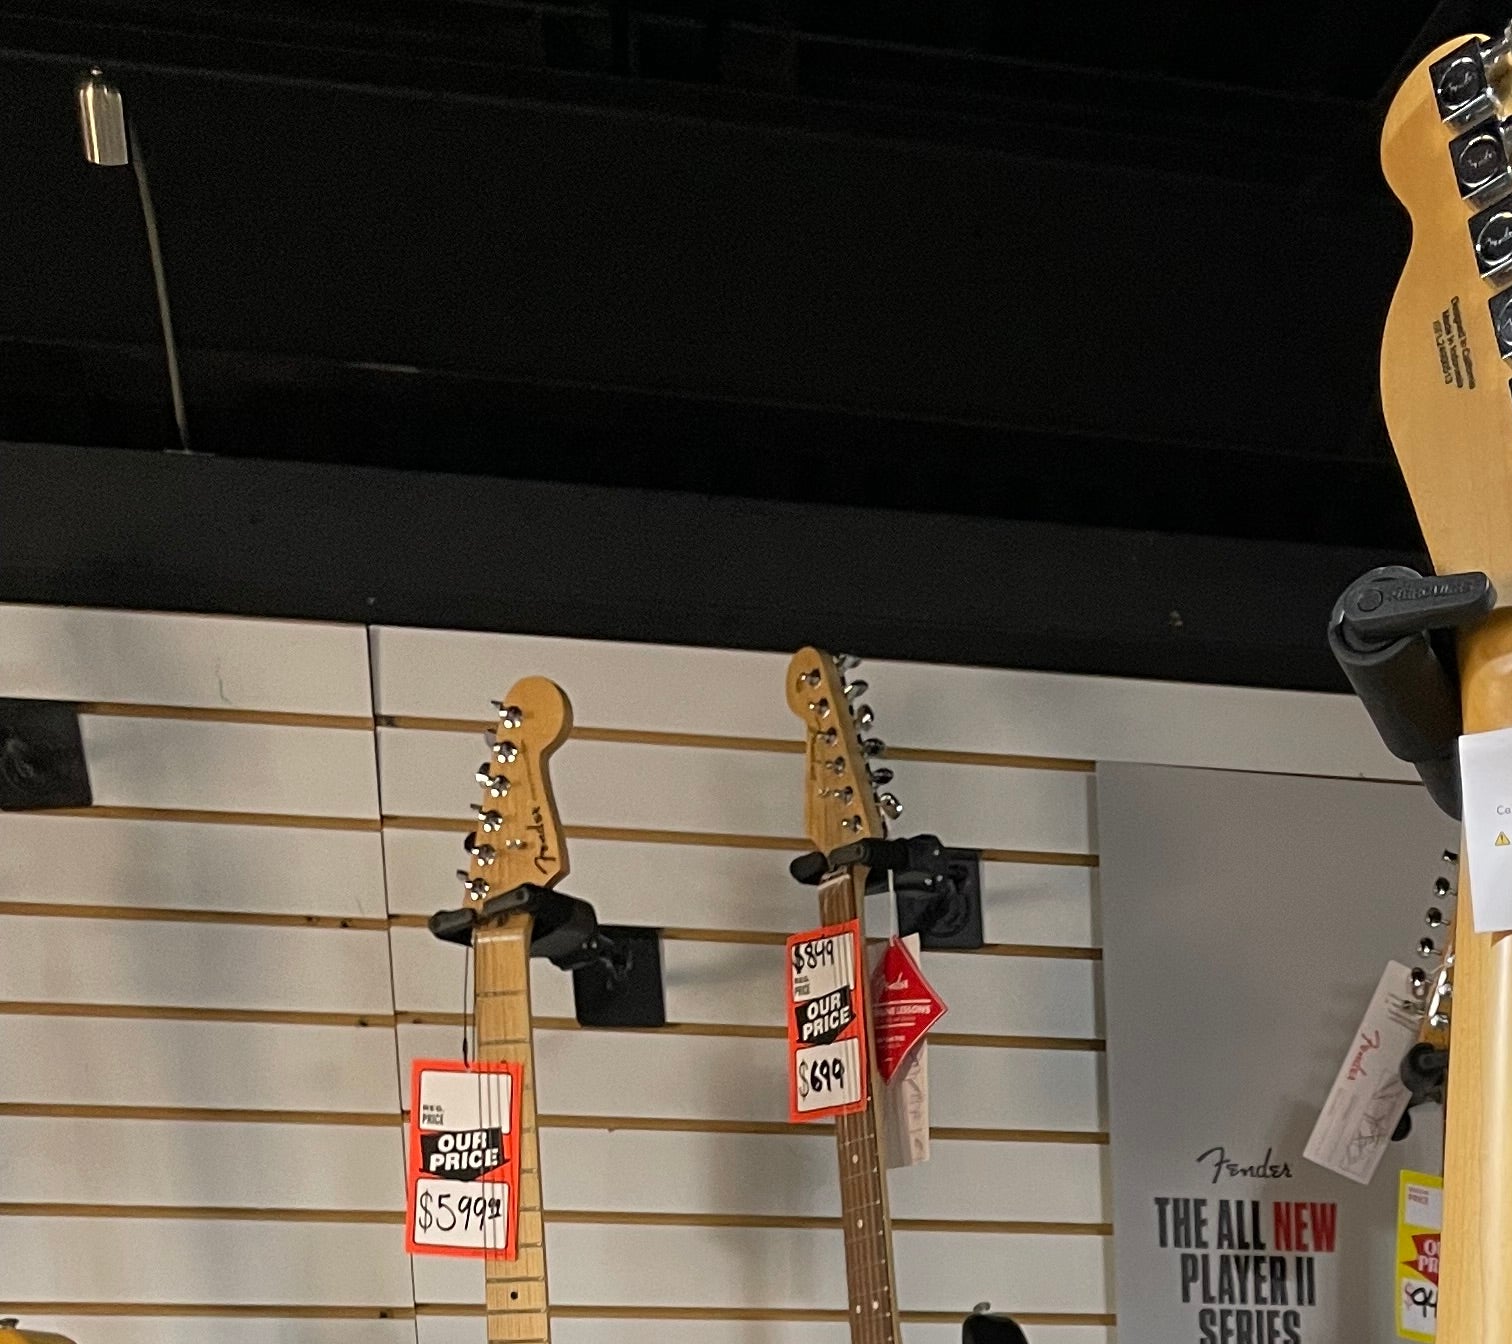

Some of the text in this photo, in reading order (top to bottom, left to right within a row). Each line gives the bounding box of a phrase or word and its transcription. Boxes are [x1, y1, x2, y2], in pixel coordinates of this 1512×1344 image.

[792, 936, 835, 974] $849
[802, 1005, 850, 1043] PRICE
[806, 991, 842, 1022] OUR
[798, 1057, 845, 1102] $699
[422, 1113, 444, 1126] PRICE
[429, 1148, 500, 1172] PRICE
[437, 1131, 488, 1154] OUR
[1196, 1146, 1293, 1184] Fender
[1154, 1197, 1337, 1252] THE ALL NEW
[1180, 1253, 1316, 1306] PLAYER II
